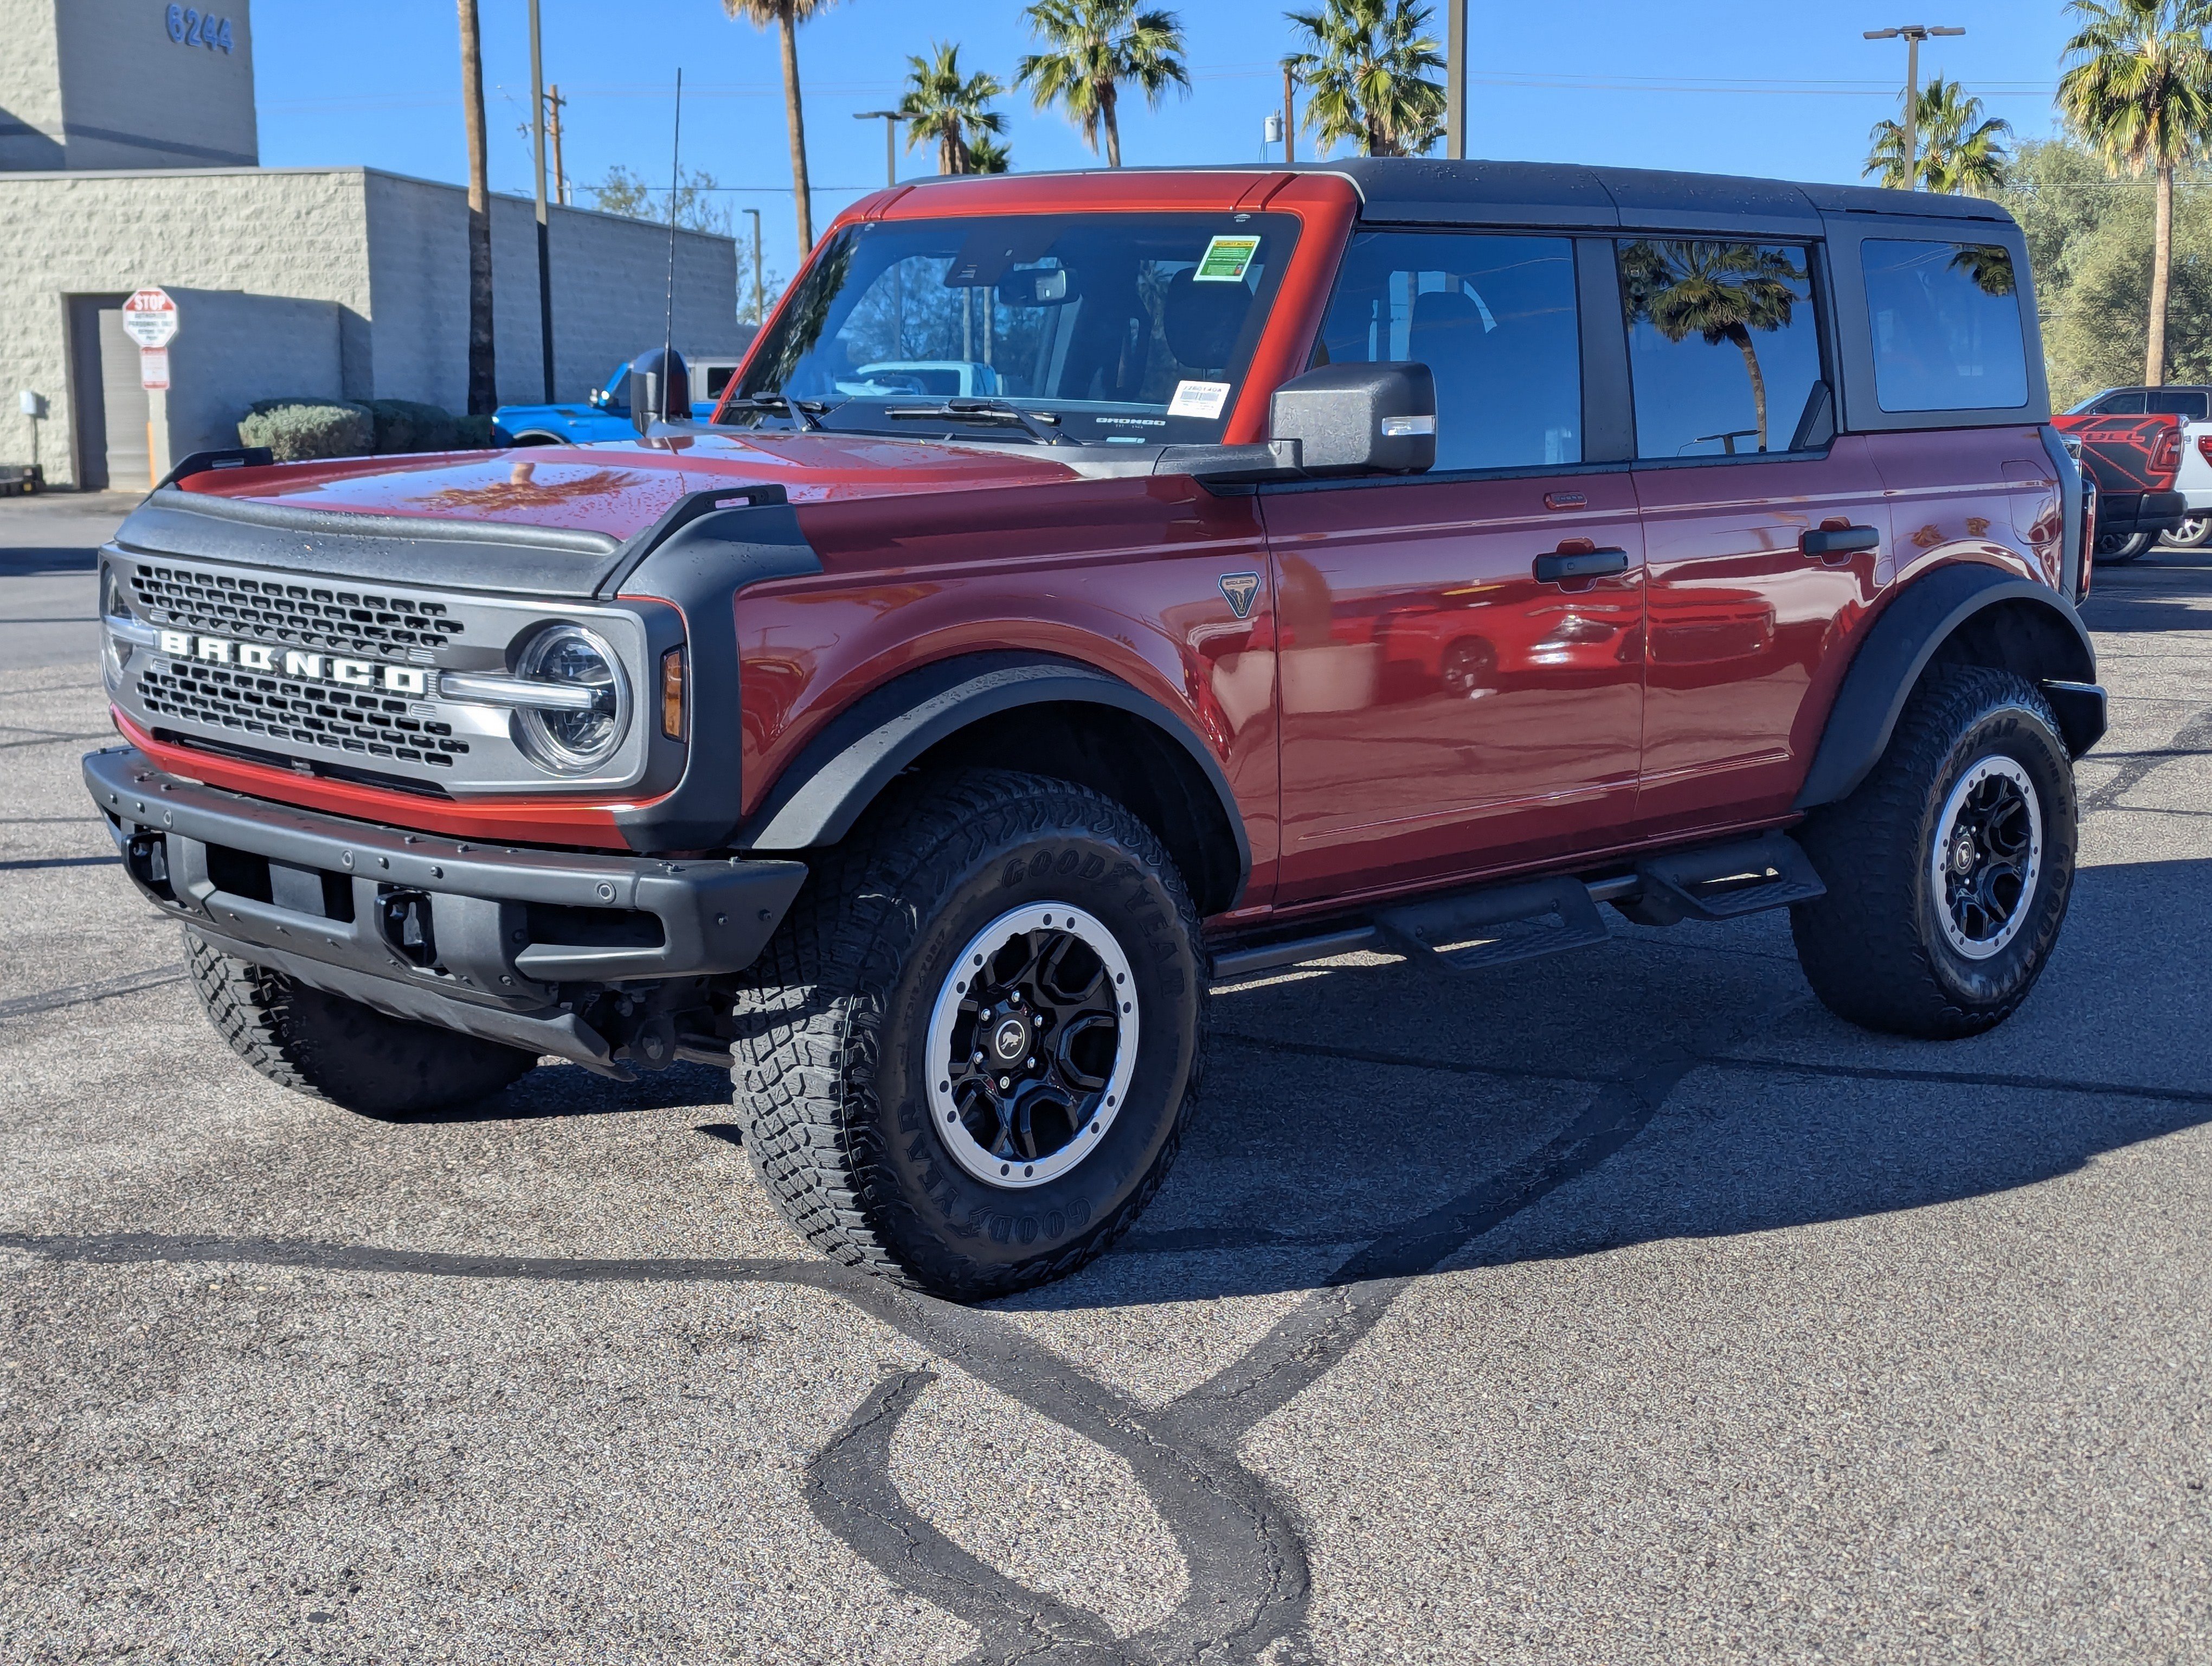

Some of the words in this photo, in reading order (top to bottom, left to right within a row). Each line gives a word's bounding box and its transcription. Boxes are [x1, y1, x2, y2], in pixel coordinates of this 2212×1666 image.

[165, 3, 235, 54] 6244
[134, 294, 166, 310] STOP
[162, 630, 427, 695] BRONCO
[1002, 848, 1186, 998] GOODYEAR
